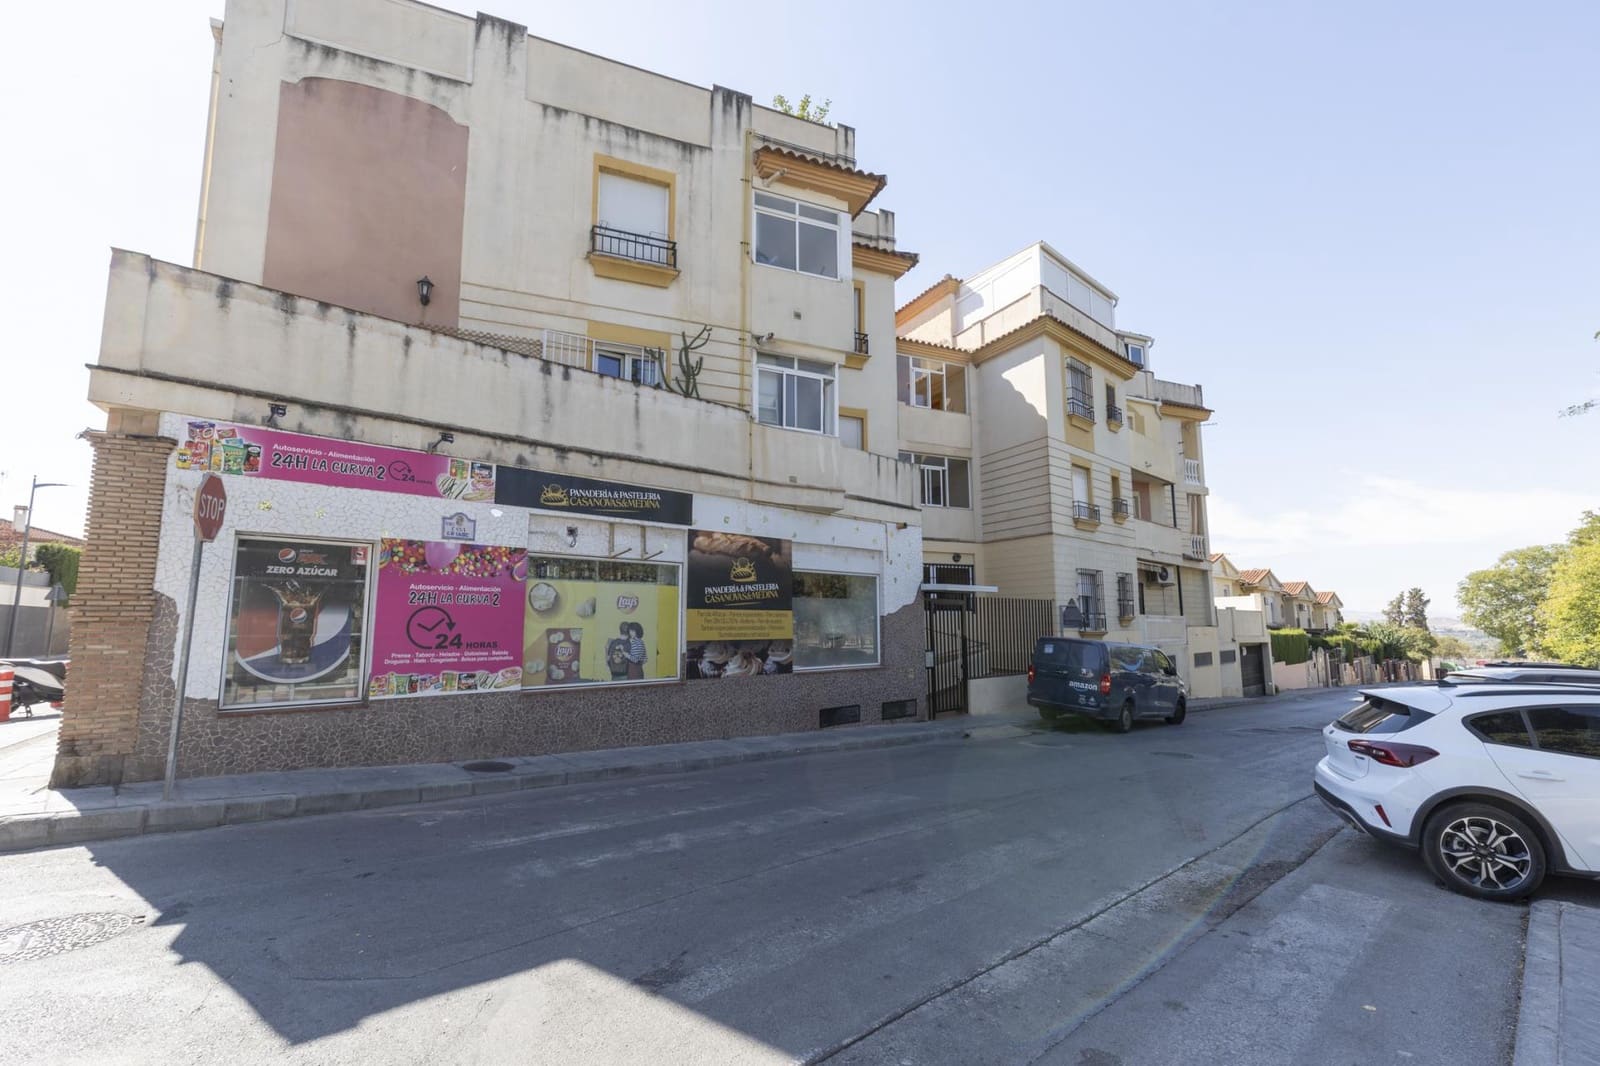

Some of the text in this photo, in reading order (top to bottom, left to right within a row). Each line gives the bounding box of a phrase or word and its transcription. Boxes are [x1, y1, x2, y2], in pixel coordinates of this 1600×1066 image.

[272, 443, 322, 455] Autoservicio
[328, 451, 376, 463] Alimentación
[271, 452, 386, 480] 24H LA CURVA 2
[401, 473, 416, 483] 24
[199, 494, 225, 521] STOP
[266, 565, 338, 577] ZERO AZÚCAR
[409, 583, 454, 591] Autoservicio
[409, 591, 500, 606] 24H LA CURVA 2
[435, 633, 498, 649] 24 HORAS
[1068, 680, 1098, 691] amazon
